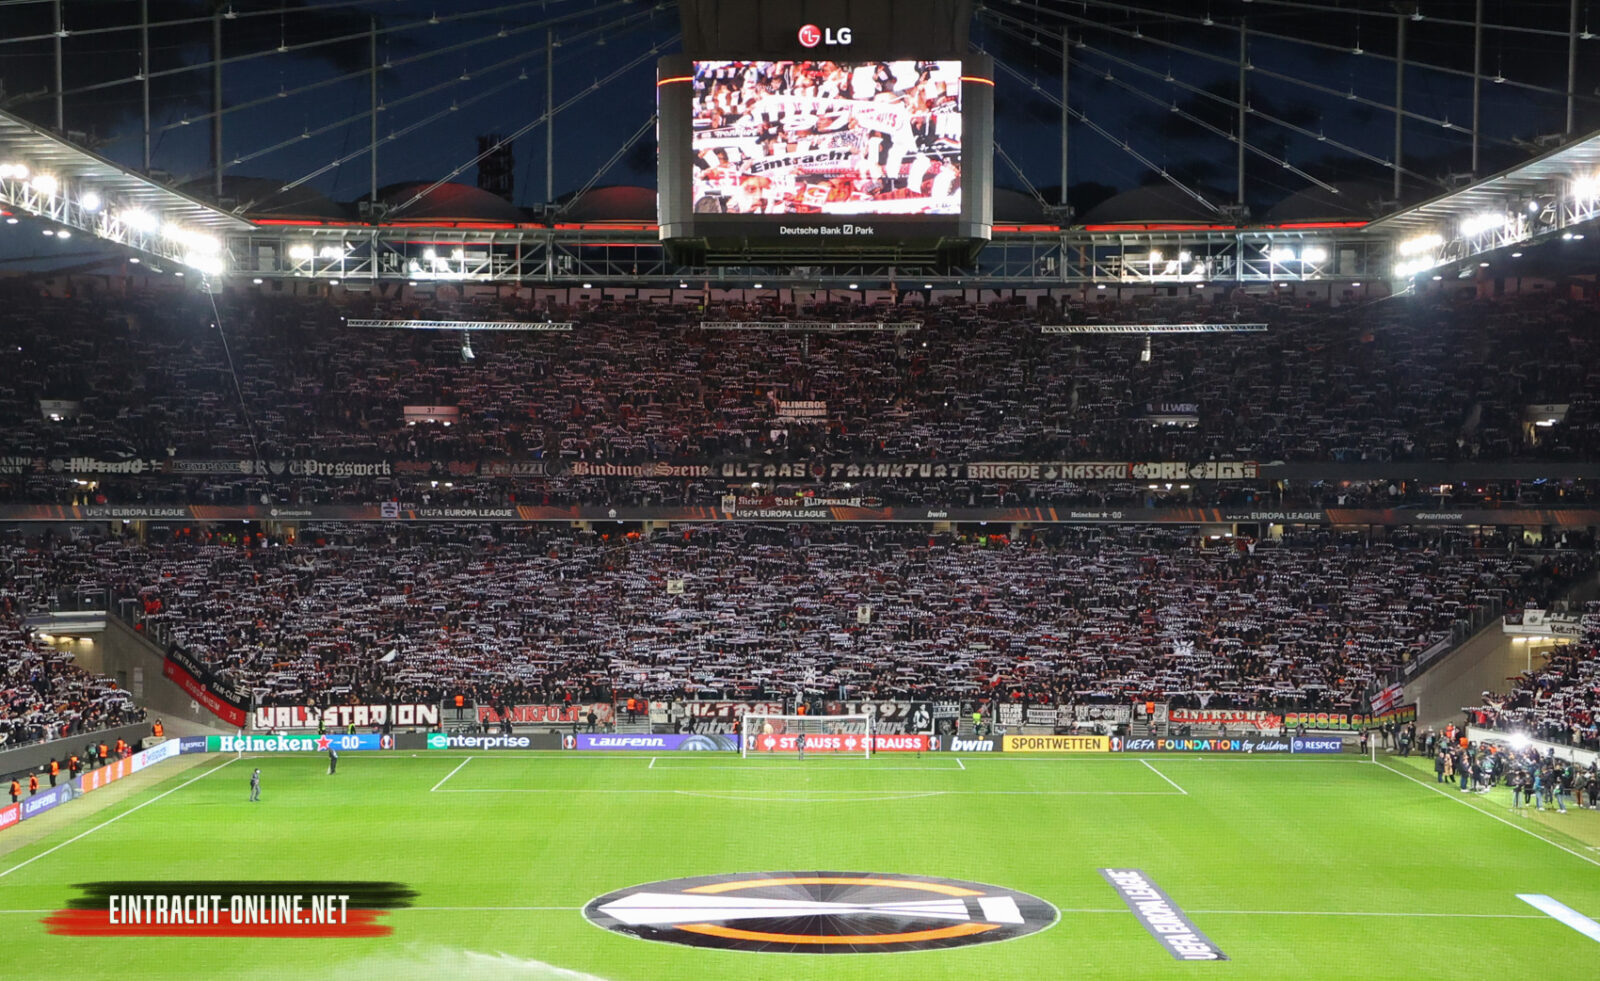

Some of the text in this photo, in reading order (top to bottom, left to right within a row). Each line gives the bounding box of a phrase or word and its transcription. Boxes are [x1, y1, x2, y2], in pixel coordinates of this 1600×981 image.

[825, 27, 852, 45] LG
[750, 151, 851, 174] Eintracht
[780, 226, 874, 235] Deutsche Bank Park
[571, 461, 709, 477] Binding Szene
[722, 463, 960, 478] ULTRAS FRANKFURT
[967, 465, 1128, 480] BRIGADE NASSAU
[86, 509, 185, 518] UEFA EUROPA LEAGUE
[420, 508, 512, 518] UEFA EUROPA LEAGUE
[736, 510, 827, 519] UEFA EUROPA LEAGUE
[927, 510, 948, 519] bwin
[1251, 511, 1285, 520] EUROPA
[1286, 511, 1321, 520] LEAGUE
[212, 682, 242, 704] FAN-CLUB
[845, 703, 912, 717] 1997
[1173, 708, 1267, 721] EINTRACHT
[220, 734, 313, 752] Heineken
[431, 734, 530, 750] enterprise
[587, 736, 667, 747] Laufenn
[950, 736, 994, 752] bwin
[1011, 737, 1101, 750] SPORTWETTEN
[1126, 738, 1289, 752] UEFA FOUNDATION for children
[1304, 741, 1342, 749] RESPECT
[1105, 868, 1218, 960] UEFA EUROPA LEAGUE
